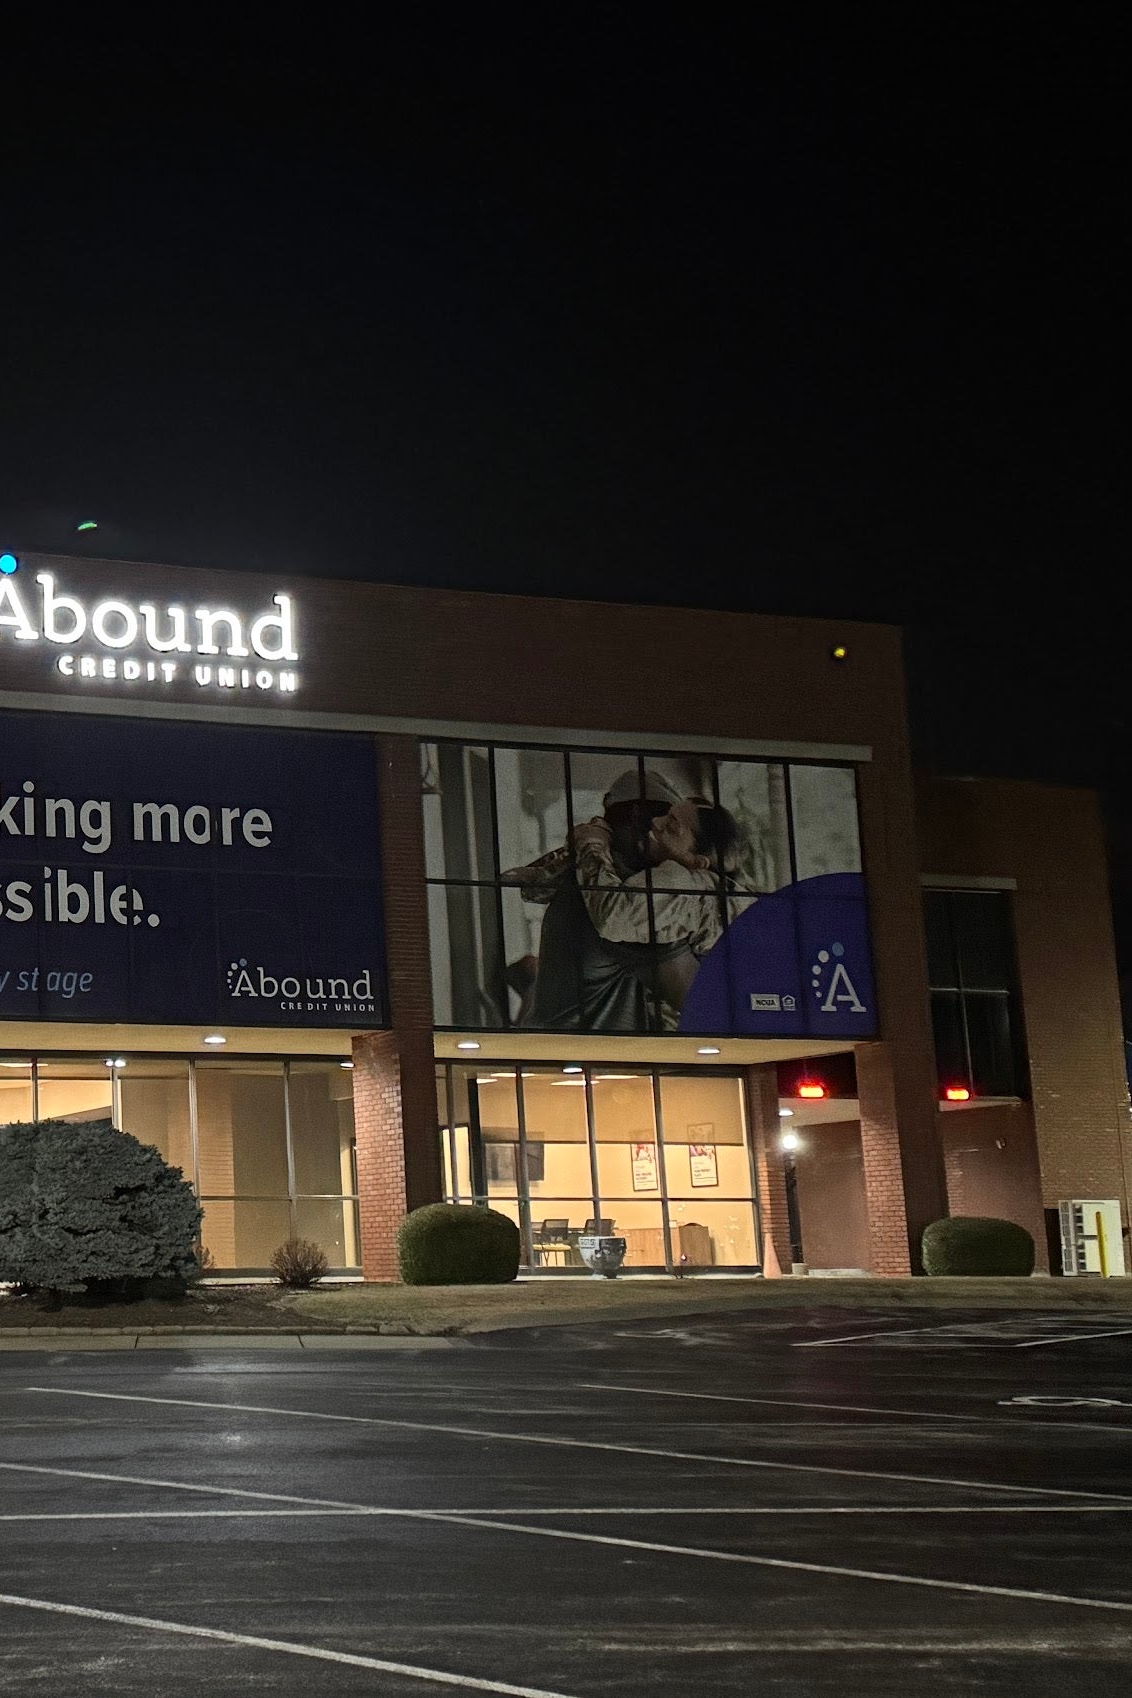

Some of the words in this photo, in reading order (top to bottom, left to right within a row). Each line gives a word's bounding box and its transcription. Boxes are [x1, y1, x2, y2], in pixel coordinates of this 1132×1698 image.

[58, 654, 177, 684] CREDIT
[194, 664, 298, 693] UNION
[133, 801, 273, 848] more
[231, 966, 374, 1000] Abound
[280, 1001, 329, 1011] CREDIT
[334, 1003, 375, 1012] UNION
[756, 999, 777, 1007] NCUA
